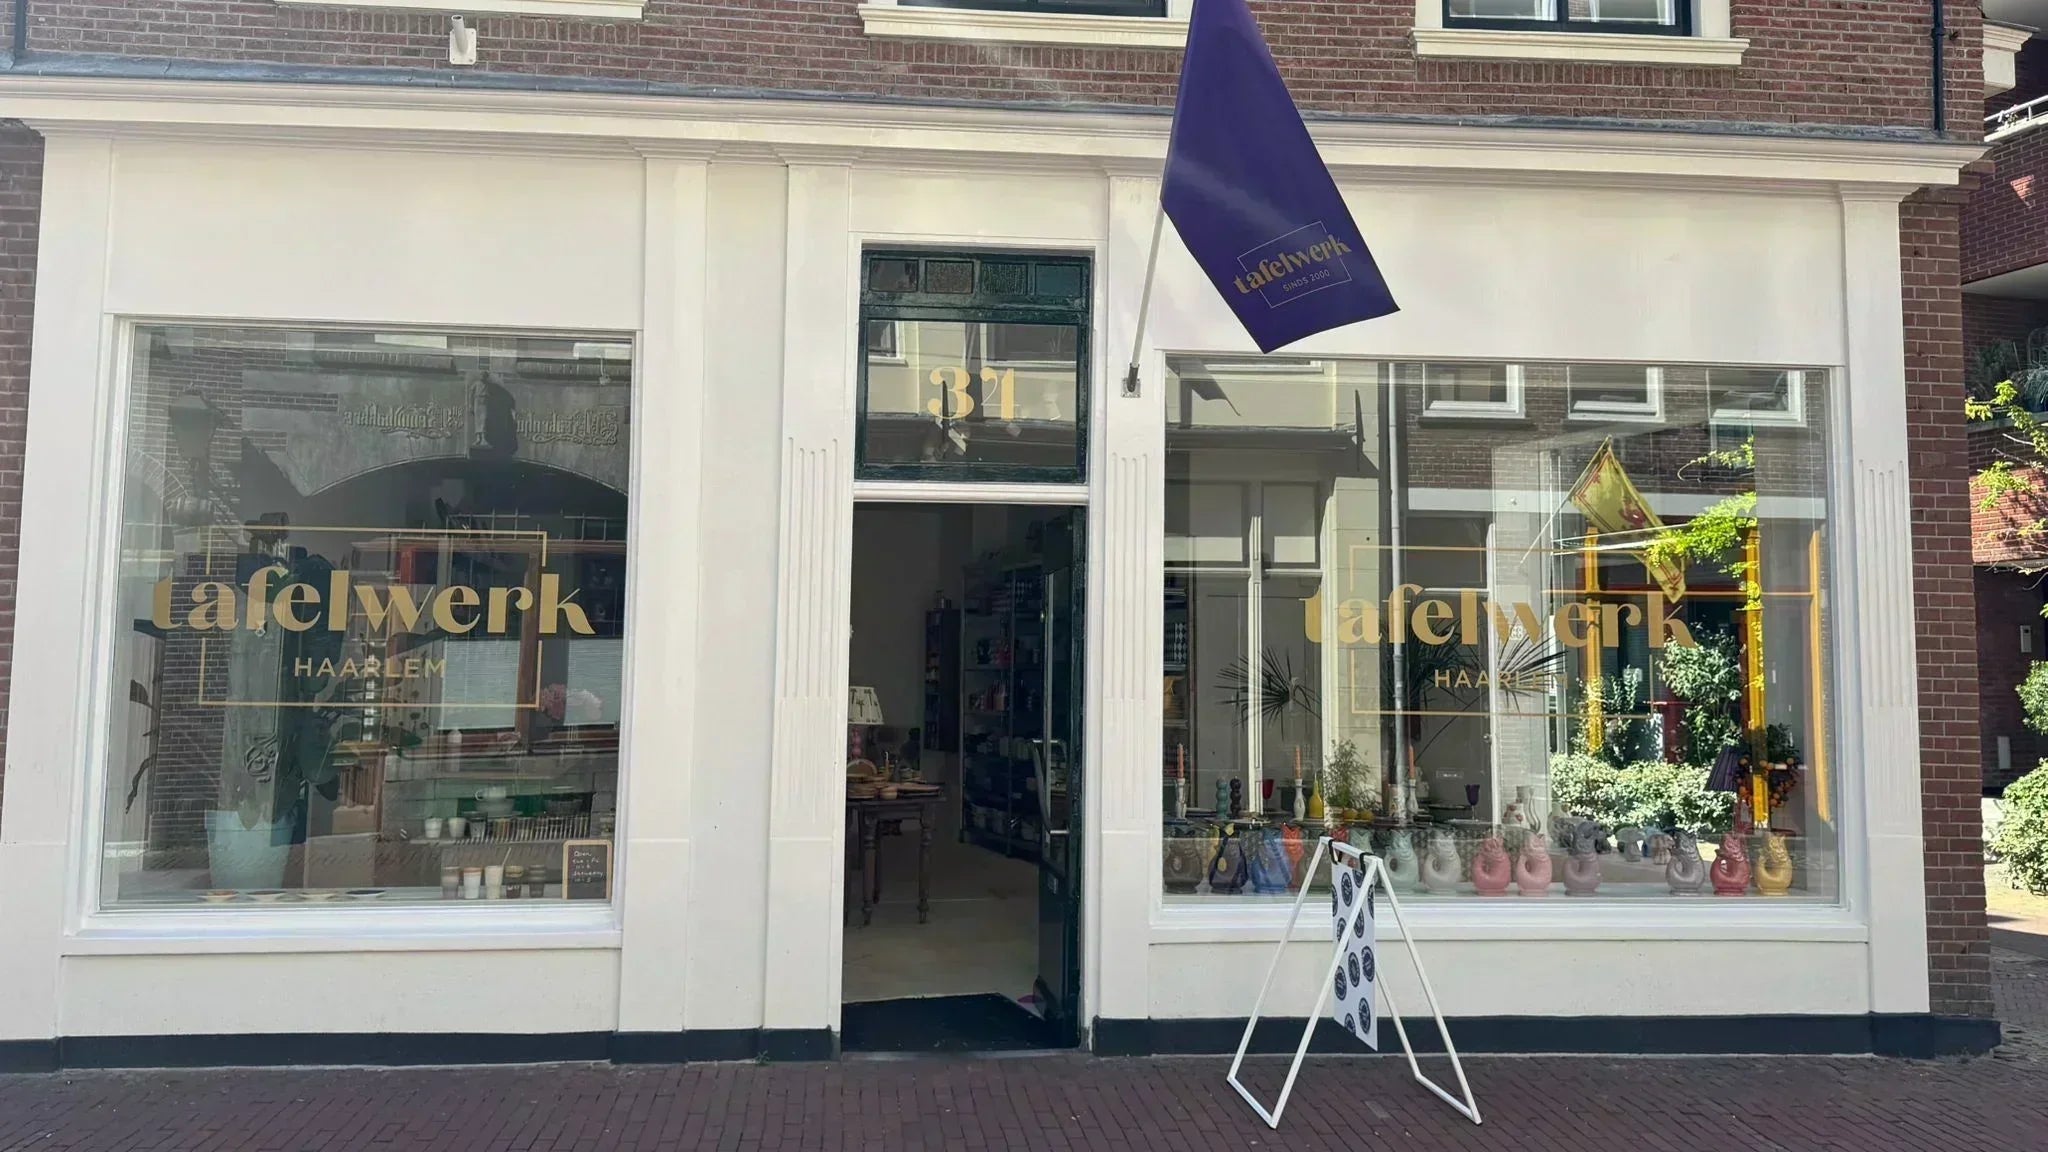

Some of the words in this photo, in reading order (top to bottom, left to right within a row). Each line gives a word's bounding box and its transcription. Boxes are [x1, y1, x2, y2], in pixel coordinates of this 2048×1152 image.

[1235, 235, 1351, 293] tafelwerk
[1283, 276, 1309, 292] SINDS
[1311, 269, 1330, 282] 2000
[152, 566, 596, 635] tafelwerk
[1301, 584, 1697, 649] tafelwerk
[294, 657, 446, 678] HAARLEM
[1434, 668, 1568, 690] HAARLEM
